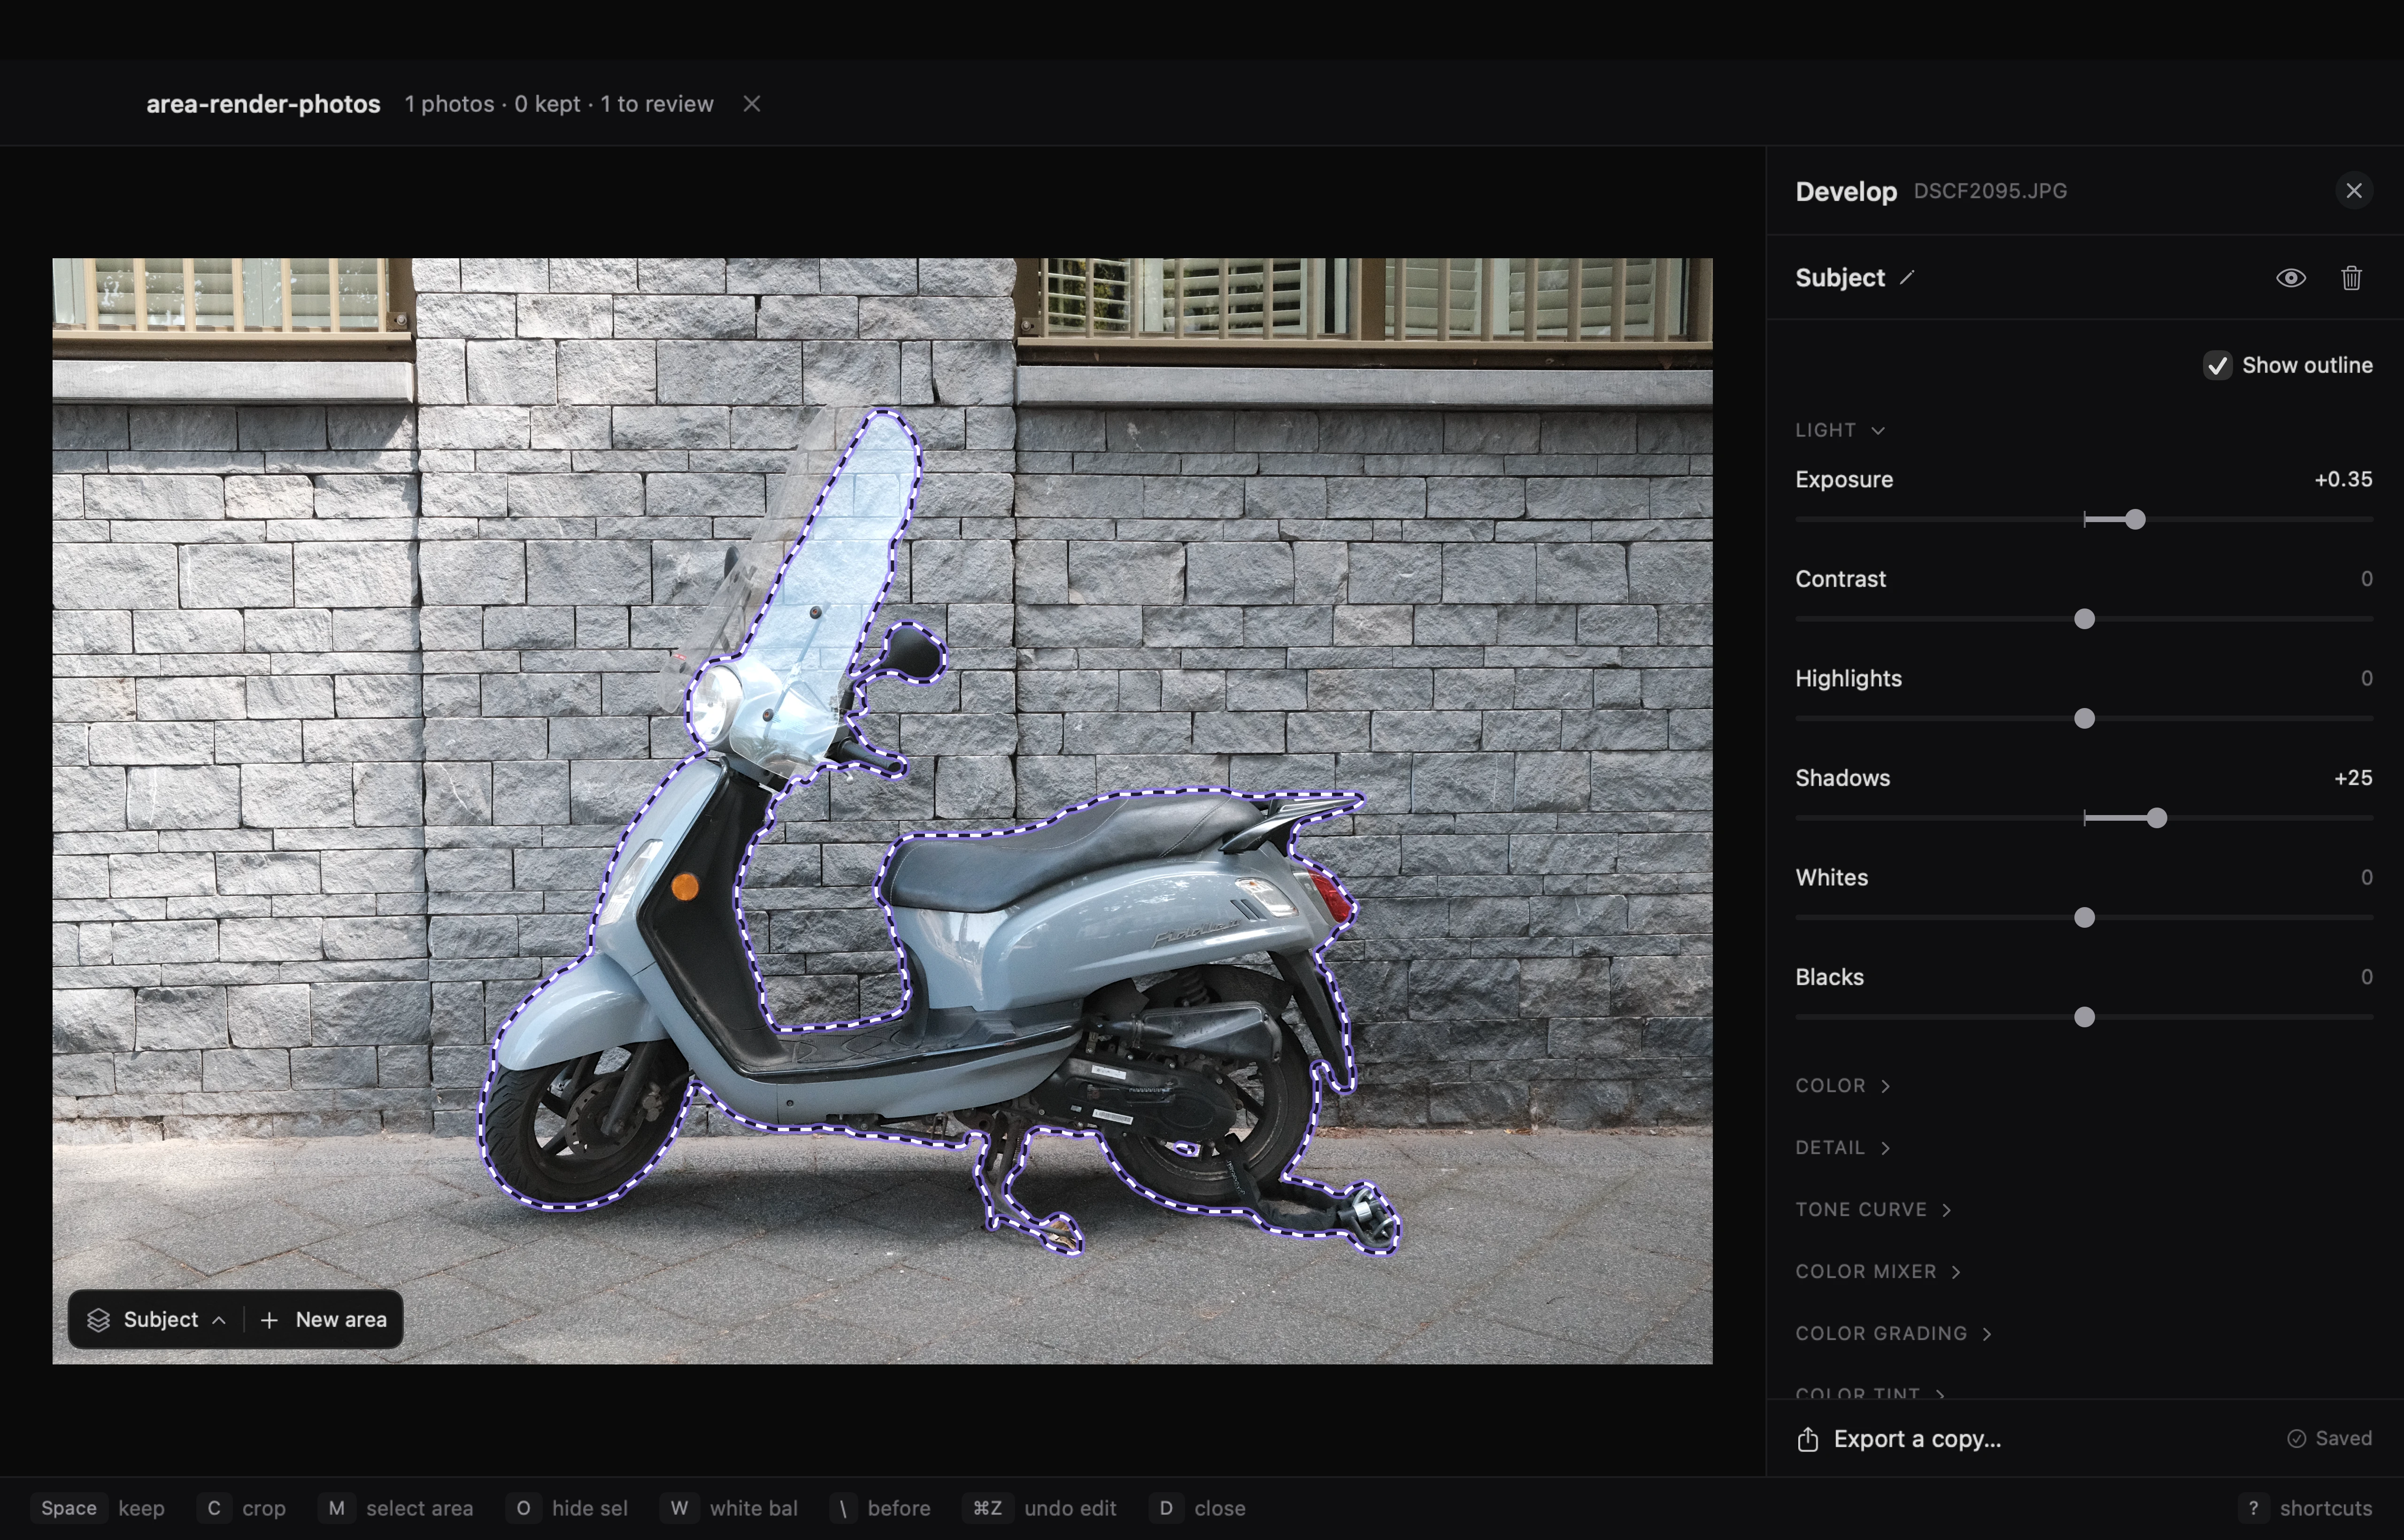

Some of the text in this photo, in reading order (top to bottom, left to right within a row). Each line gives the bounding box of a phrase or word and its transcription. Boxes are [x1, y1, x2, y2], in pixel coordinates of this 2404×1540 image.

[147, 94, 380, 117] area-render-photos
[406, 96, 412, 112] 1
[423, 95, 494, 116] photos
[516, 95, 527, 112] 0
[536, 95, 580, 116] kept
[602, 96, 609, 112] 1
[618, 97, 638, 112] to
[647, 95, 714, 112] review
[1797, 181, 1897, 206] Develop
[1916, 183, 2066, 198] DSCF2095.JPG
[1796, 267, 1885, 291] Subject
[2243, 356, 2373, 373] Show outline
[1796, 423, 1856, 437] LIGHT
[1797, 470, 1893, 491] Exposure
[2316, 470, 2372, 487] +0.35
[1796, 570, 1887, 587] Contrast
[2362, 571, 2373, 586] 0
[1797, 669, 1902, 691] Highlights
[2362, 670, 2373, 686] 0
[1796, 769, 1890, 786] Shadows
[2335, 769, 2372, 785] +25
[1796, 868, 1868, 886] Whites
[2362, 870, 2373, 885] 0
[1797, 968, 1864, 985] Blacks
[2362, 969, 2373, 985] 0
[1796, 1078, 1865, 1093] COLOR
[1796, 1140, 1865, 1154] DETAIL
[1796, 1202, 1926, 1217] TONE CURVE
[1796, 1264, 1935, 1278] COLOR MIXER
[125, 1311, 198, 1331] Subject
[297, 1312, 386, 1327] New area
[1796, 1326, 1966, 1340] COLOR GRADING
[1836, 1430, 1904, 1452] Export
[1913, 1434, 1923, 1447] a
[2317, 1430, 2372, 1446] Saved
[42, 1501, 97, 1518] Space
[120, 1500, 164, 1519] keep
[208, 1501, 220, 1515] C
[243, 1504, 285, 1519] crop
[330, 1501, 344, 1515] M
[367, 1500, 472, 1516] select area
[517, 1501, 530, 1515] O
[554, 1500, 627, 1516] hide sel
[671, 1501, 688, 1515] W
[710, 1500, 797, 1516] white bal
[869, 1500, 931, 1516] before
[1025, 1500, 1117, 1516] undo edit
[1161, 1501, 1173, 1515] D
[1195, 1500, 1245, 1516] close
[2250, 1501, 2258, 1515] ?
[2281, 1500, 2372, 1516] shortcuts
